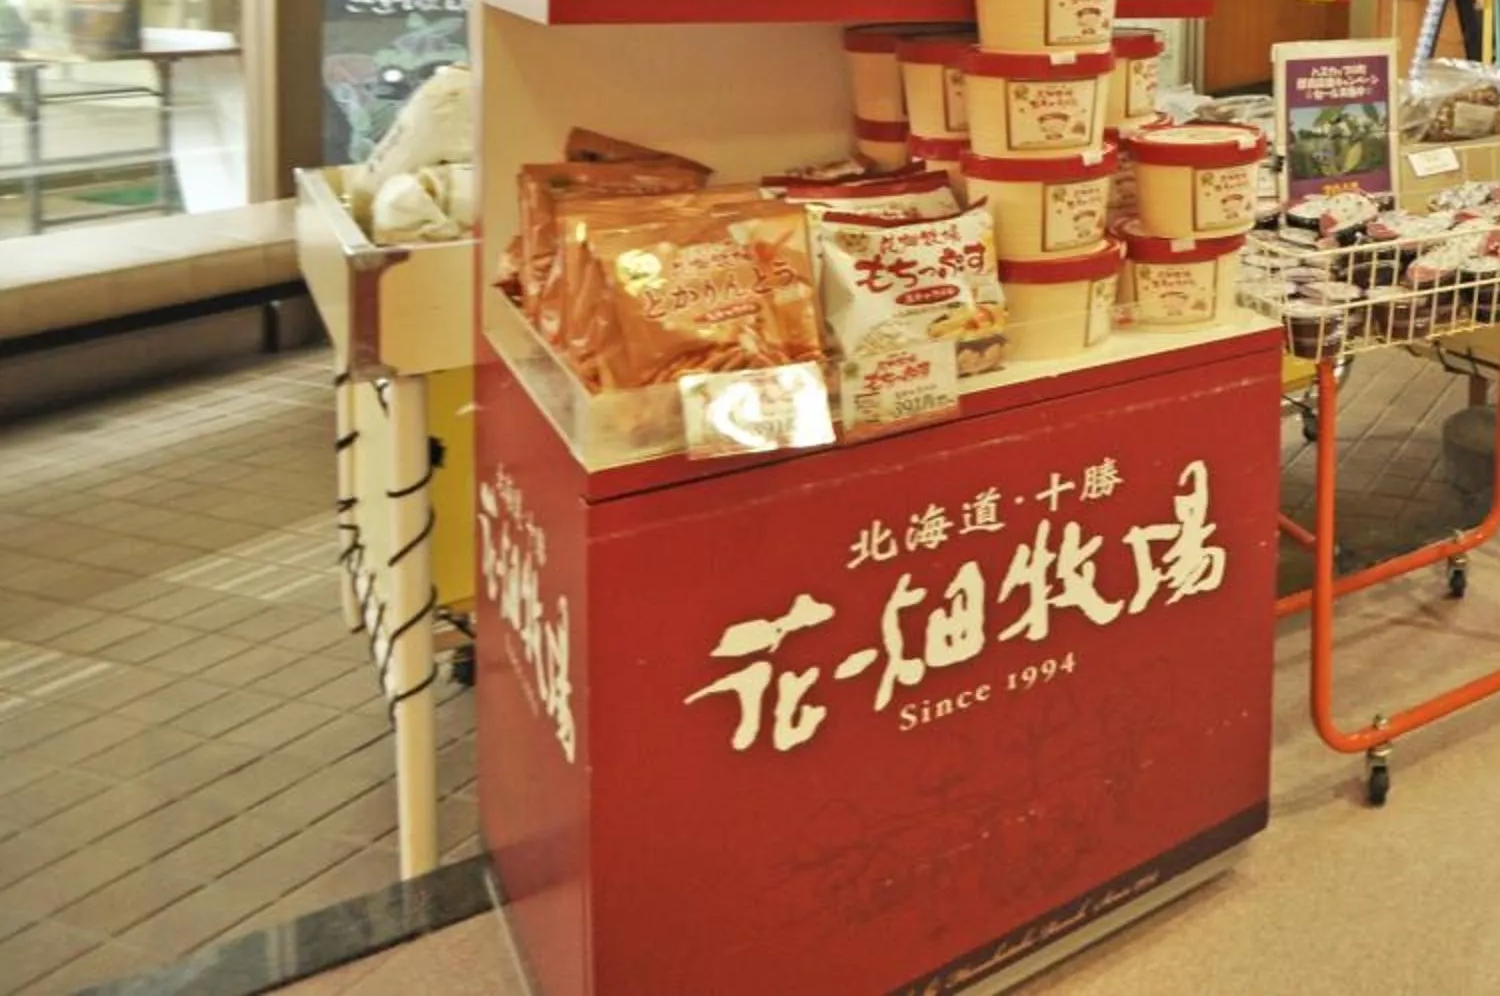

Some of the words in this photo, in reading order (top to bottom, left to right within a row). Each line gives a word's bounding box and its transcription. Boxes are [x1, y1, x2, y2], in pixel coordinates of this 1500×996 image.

[855, 243, 987, 294] もちっぷす
[846, 456, 1124, 569] 北海道・十勝
[683, 460, 1226, 751] 花畑牧場
[899, 681, 993, 731] Since
[1006, 650, 1078, 692] 1994
